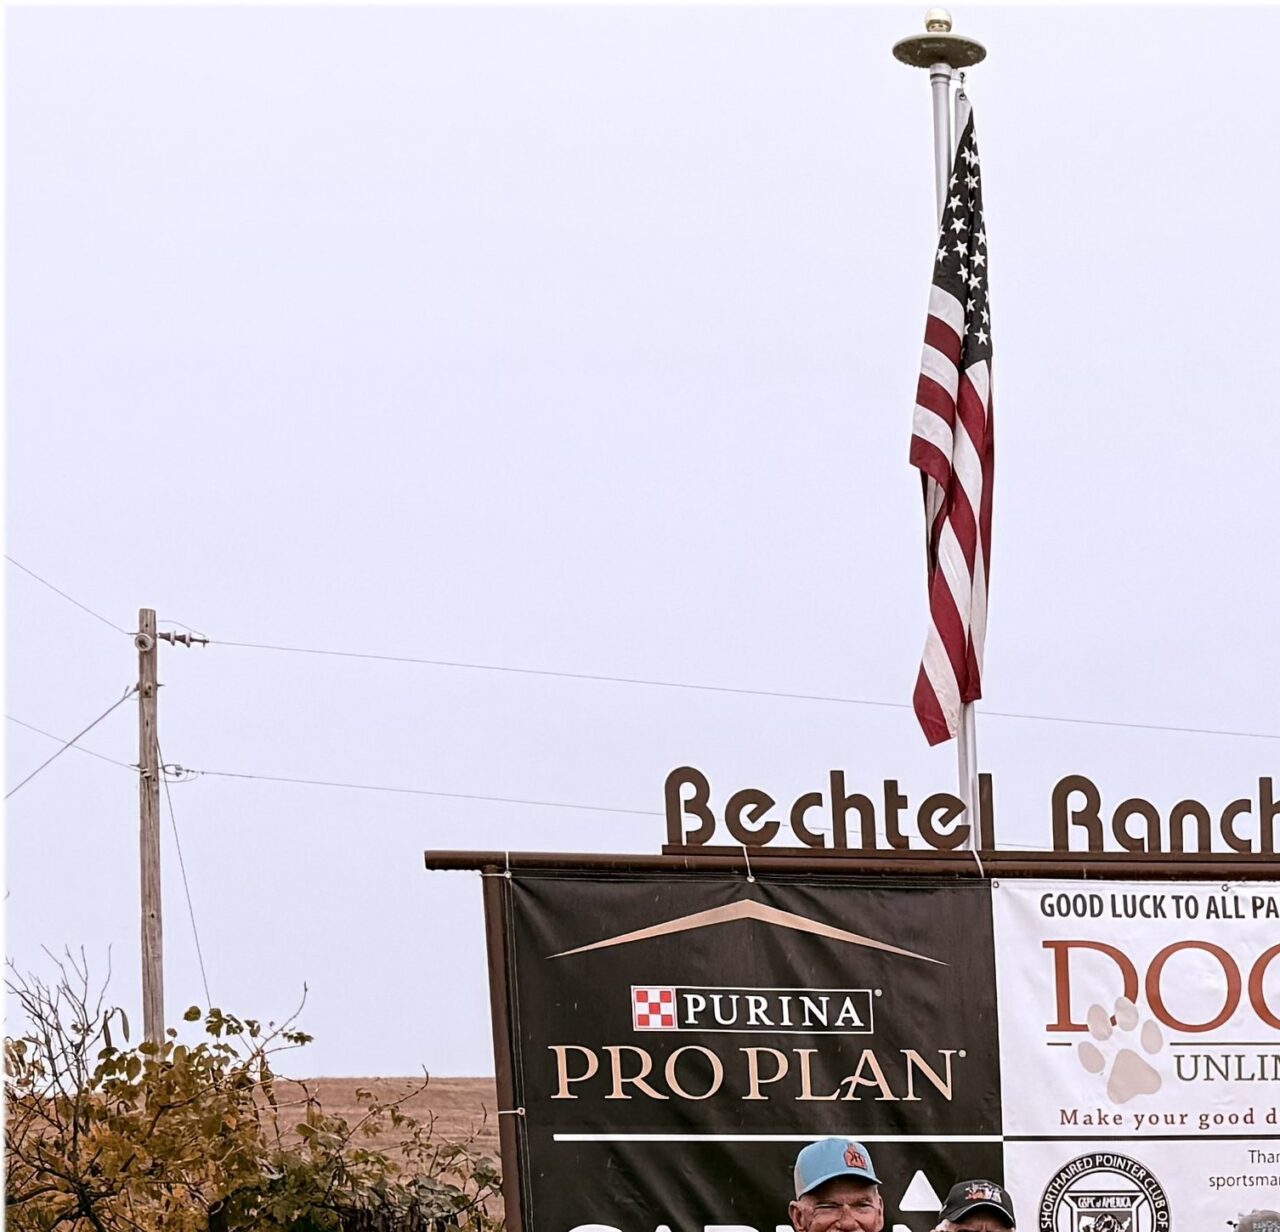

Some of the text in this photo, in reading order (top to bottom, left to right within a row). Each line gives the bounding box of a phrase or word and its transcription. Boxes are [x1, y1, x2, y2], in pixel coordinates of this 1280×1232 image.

[664, 766, 993, 851] Bechtel
[1040, 892, 1103, 918] GOOD
[1111, 894, 1166, 919] LUCK
[1169, 895, 1199, 920] TO
[1206, 895, 1246, 920] ALL
[684, 993, 865, 1028] PURINA
[548, 1045, 957, 1102] PRO PLAN
[1060, 1109, 1124, 1126] Make
[1134, 1111, 1189, 1130] your
[1199, 1108, 1256, 1130] good
[1041, 1157, 1093, 1229] SHORTHAIRED
[1095, 1154, 1147, 1181] POINTER
[1143, 1177, 1165, 1209] CLUB
[1156, 1210, 1168, 1229] OF
